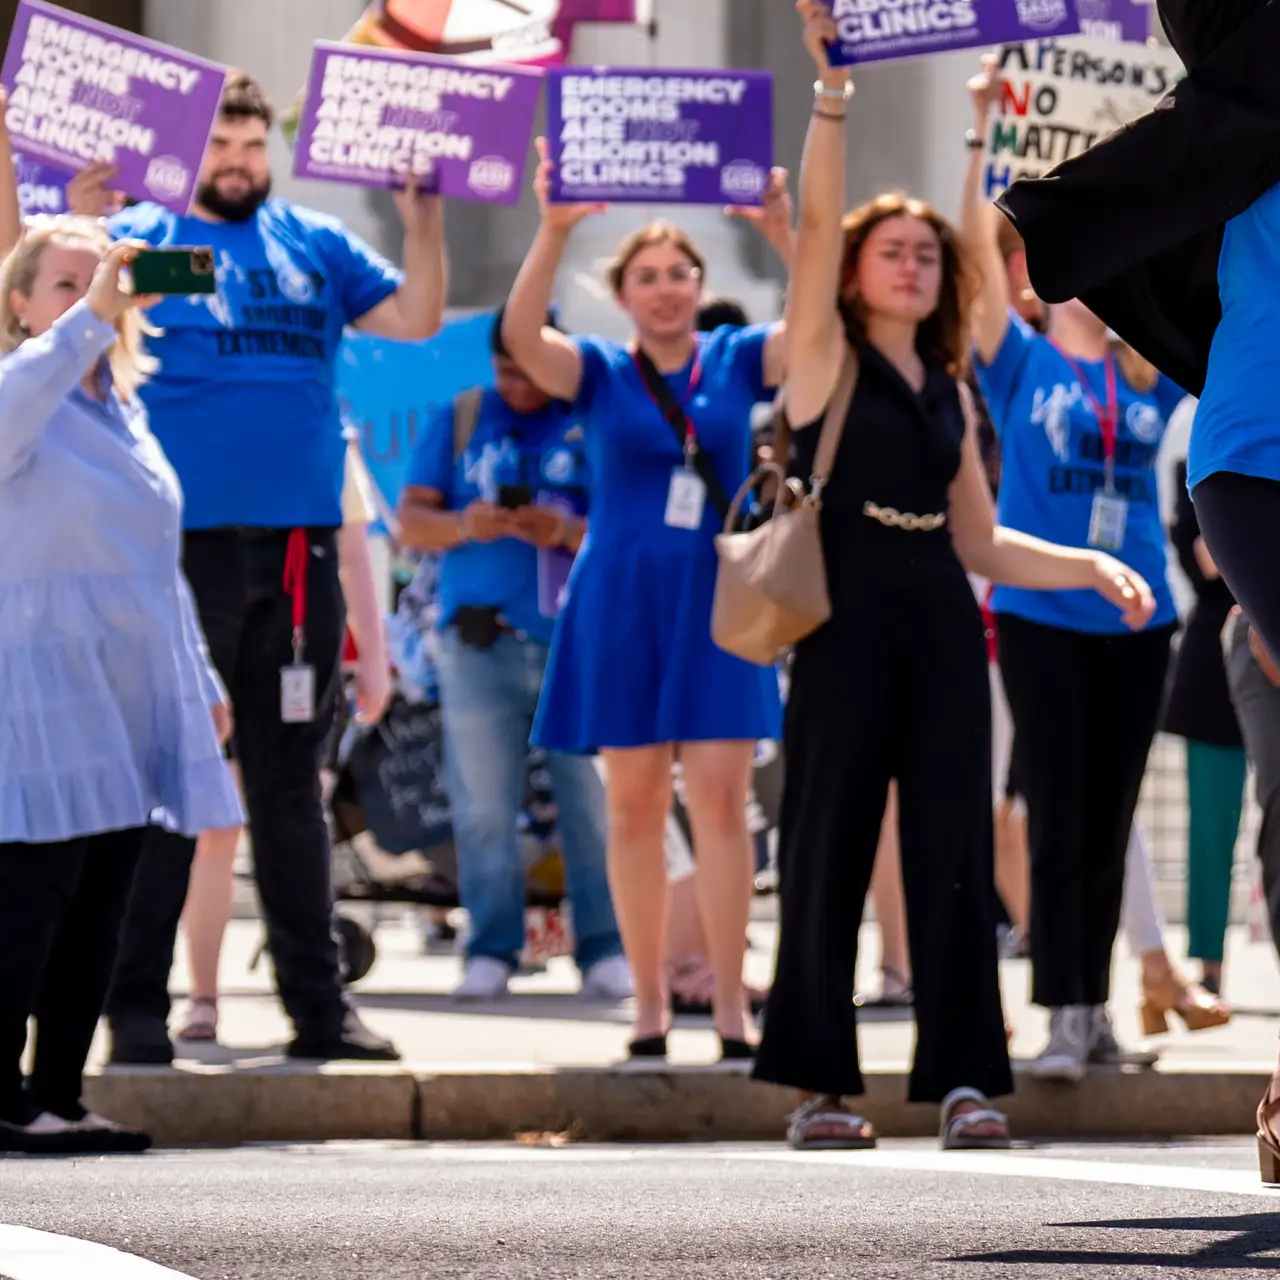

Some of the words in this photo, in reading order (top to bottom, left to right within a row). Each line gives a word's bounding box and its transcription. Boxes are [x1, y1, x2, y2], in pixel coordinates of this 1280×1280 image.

[836, 0, 978, 43] CLINICS
[21, 37, 129, 95] ROOMS
[28, 14, 201, 95] EMERGENCY
[14, 61, 74, 98] ARE
[320, 73, 442, 112] ROOMS
[322, 55, 514, 101] EMERGENCY
[560, 75, 746, 104] EMERGENCY
[315, 97, 381, 125] ARE
[560, 96, 681, 122] ROOMS
[1001, 80, 1057, 116] NO
[8, 83, 157, 156] ABORTION
[559, 119, 625, 143] ARE
[309, 138, 434, 176] CLINICS
[311, 120, 473, 161] ABORTION
[559, 140, 719, 167] ABORTION
[559, 161, 686, 187] CLINICS
